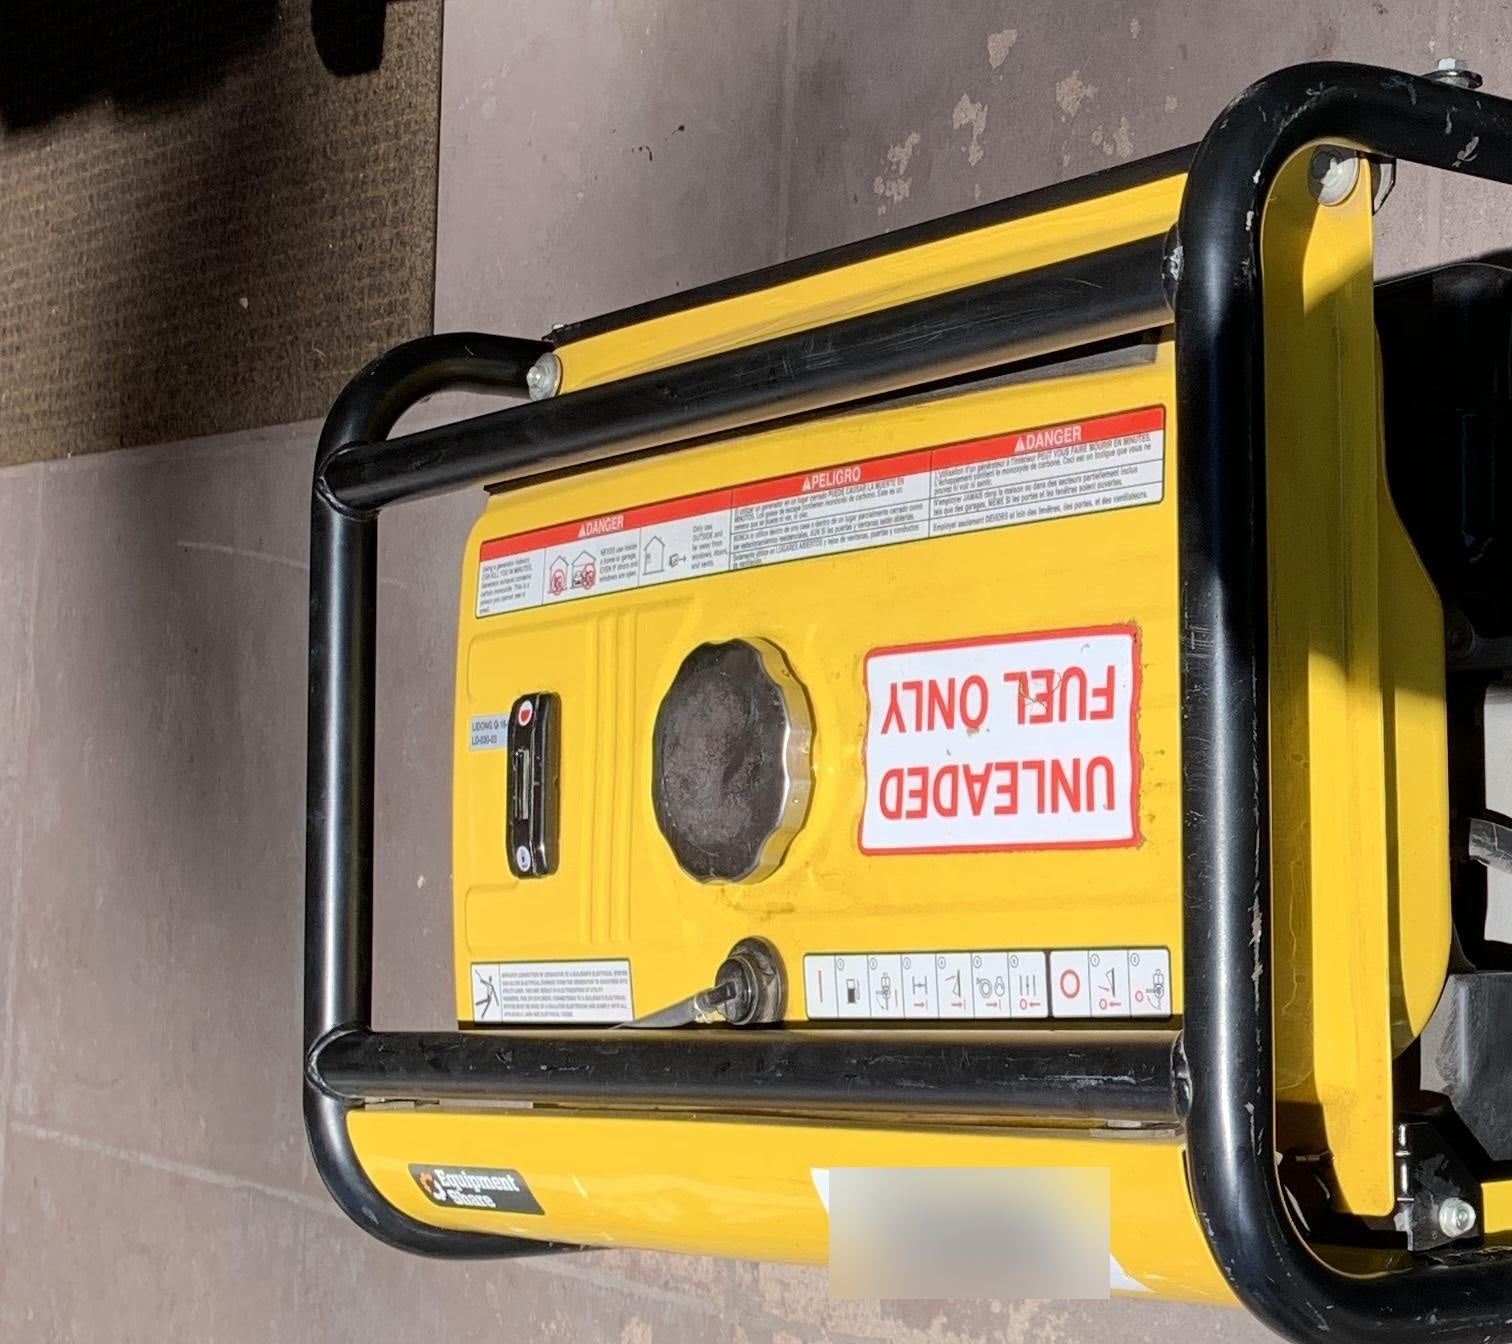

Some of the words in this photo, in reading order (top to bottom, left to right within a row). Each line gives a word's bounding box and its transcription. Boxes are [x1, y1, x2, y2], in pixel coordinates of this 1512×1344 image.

[1026, 426, 1081, 450] DANGER
[812, 467, 861, 490] PELIGRO
[586, 515, 624, 534] DANGER
[881, 675, 989, 734] ONLY
[1004, 665, 1115, 725] FUEL
[879, 756, 1116, 820] UNLEADED
[433, 1168, 520, 1193] Equipment
[447, 1188, 496, 1208] Share
